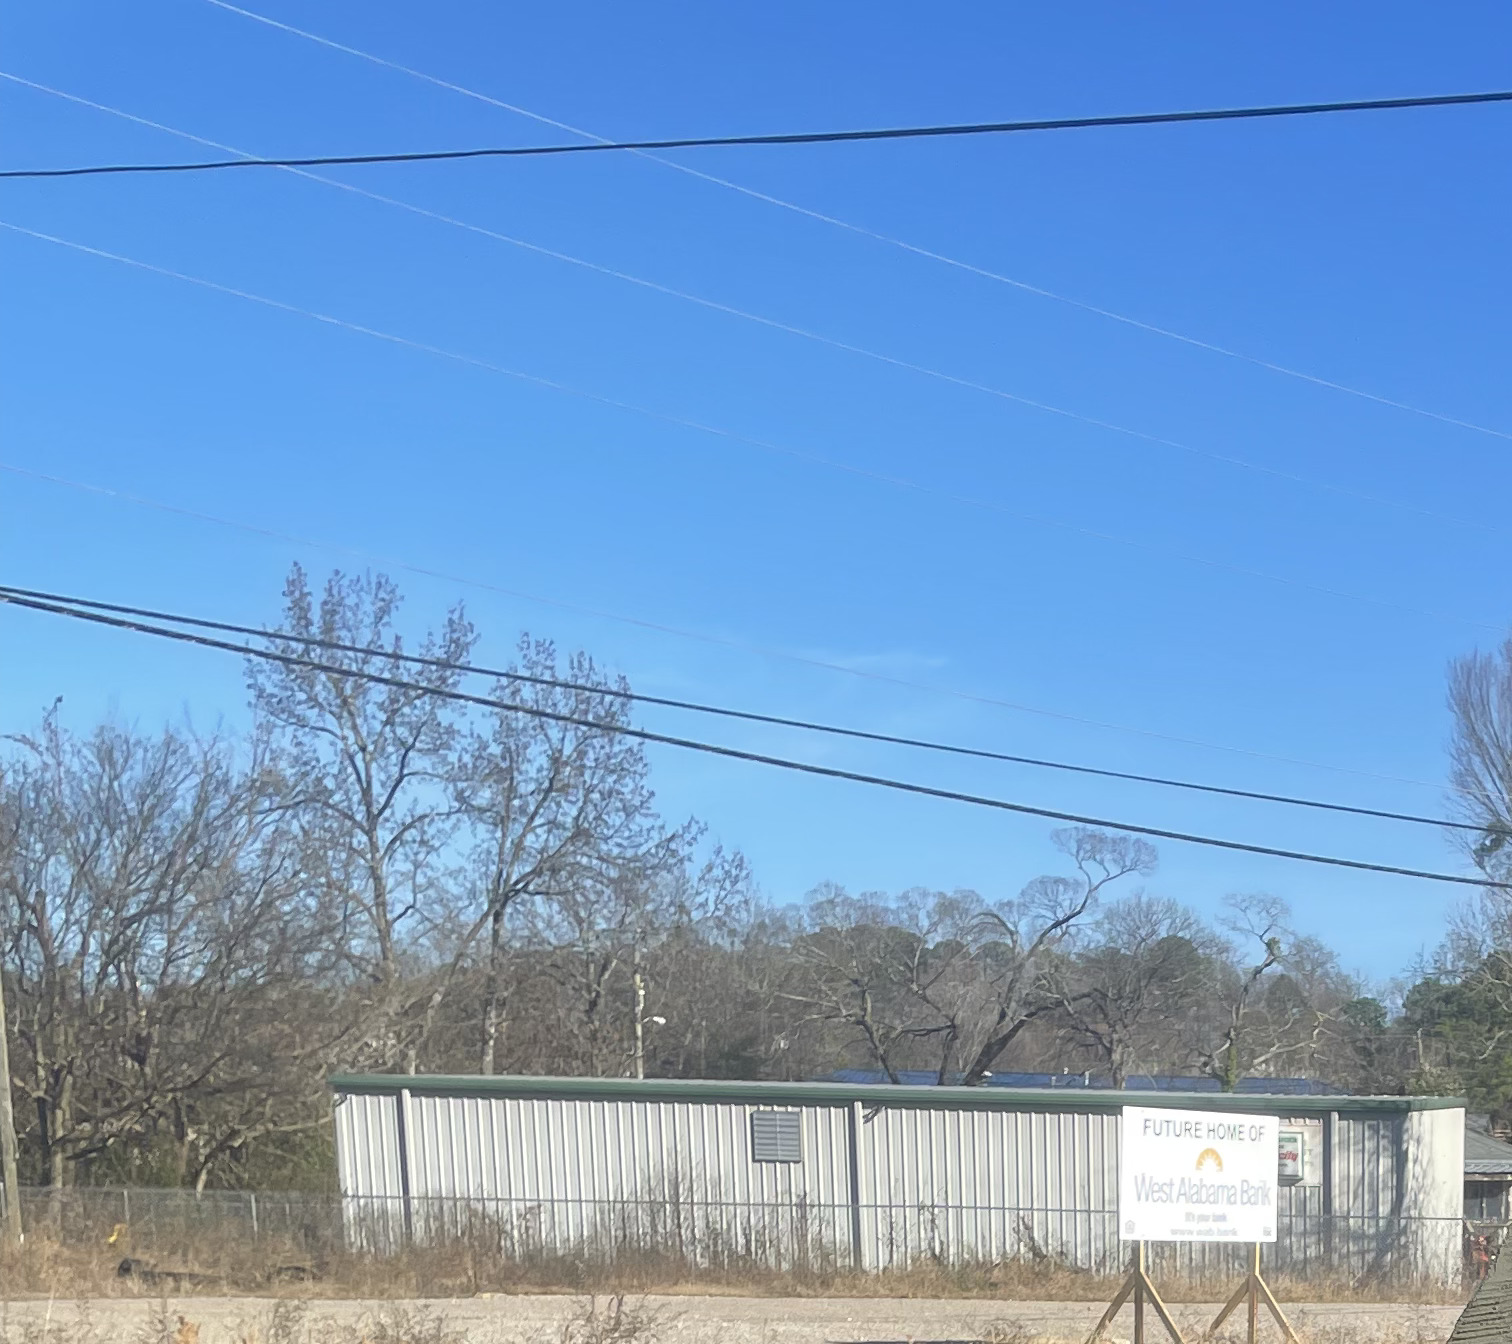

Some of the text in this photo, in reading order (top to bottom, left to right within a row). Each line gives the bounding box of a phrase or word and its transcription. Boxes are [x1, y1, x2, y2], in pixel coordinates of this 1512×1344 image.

[1143, 1118, 1265, 1142] FUTURE HOME OF
[1134, 1173, 1272, 1206] West Alabama Bank
